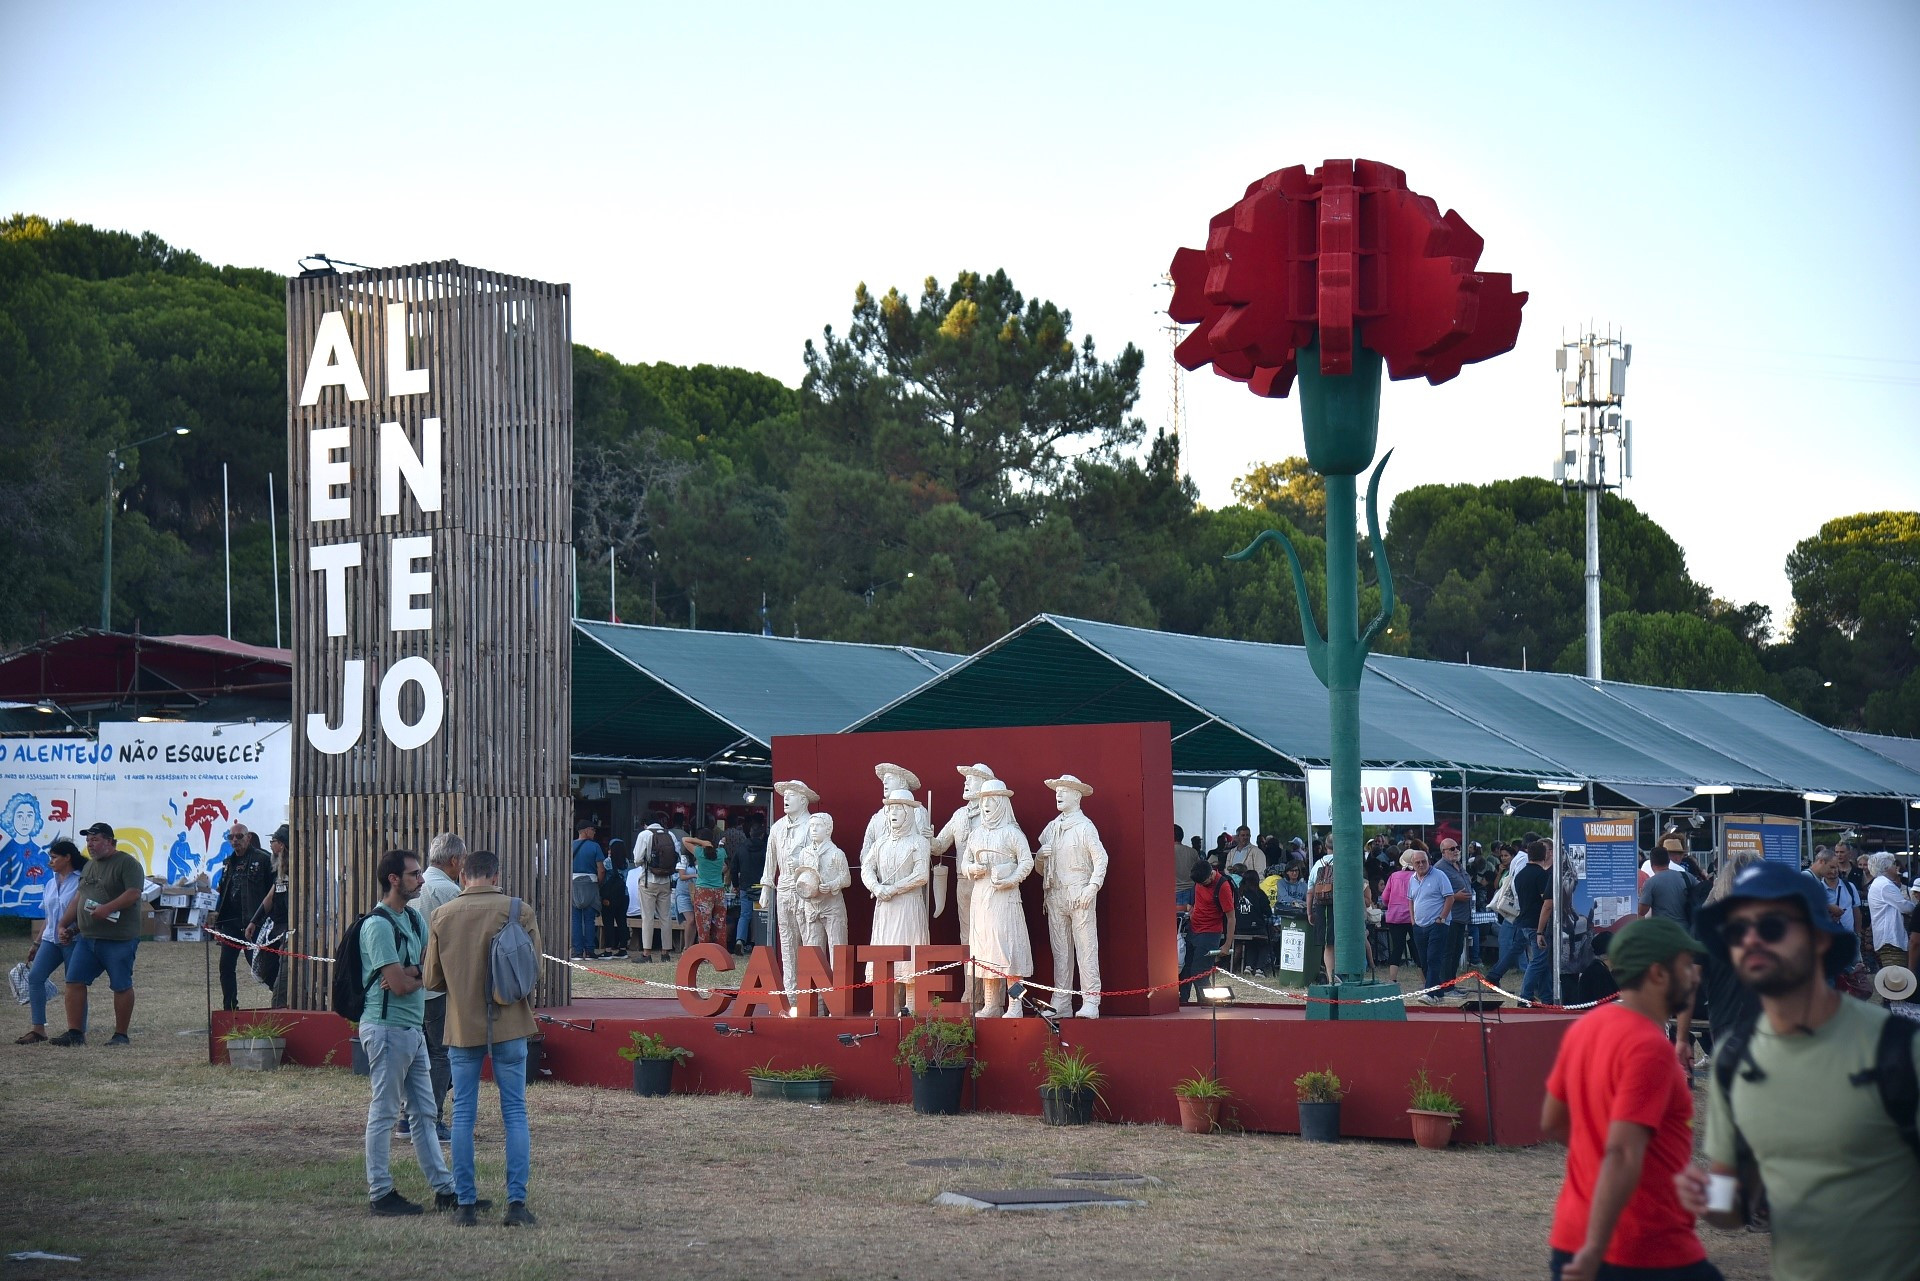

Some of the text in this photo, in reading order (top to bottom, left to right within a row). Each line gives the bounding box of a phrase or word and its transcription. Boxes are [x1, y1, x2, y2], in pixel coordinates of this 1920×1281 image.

[13, 743, 113, 764] ALENTEJO
[119, 738, 158, 763] NÃO
[1590, 823, 1615, 837] FASCISMO
[1615, 824, 1633, 837] EXISTIU
[675, 942, 971, 1017] CANTE
